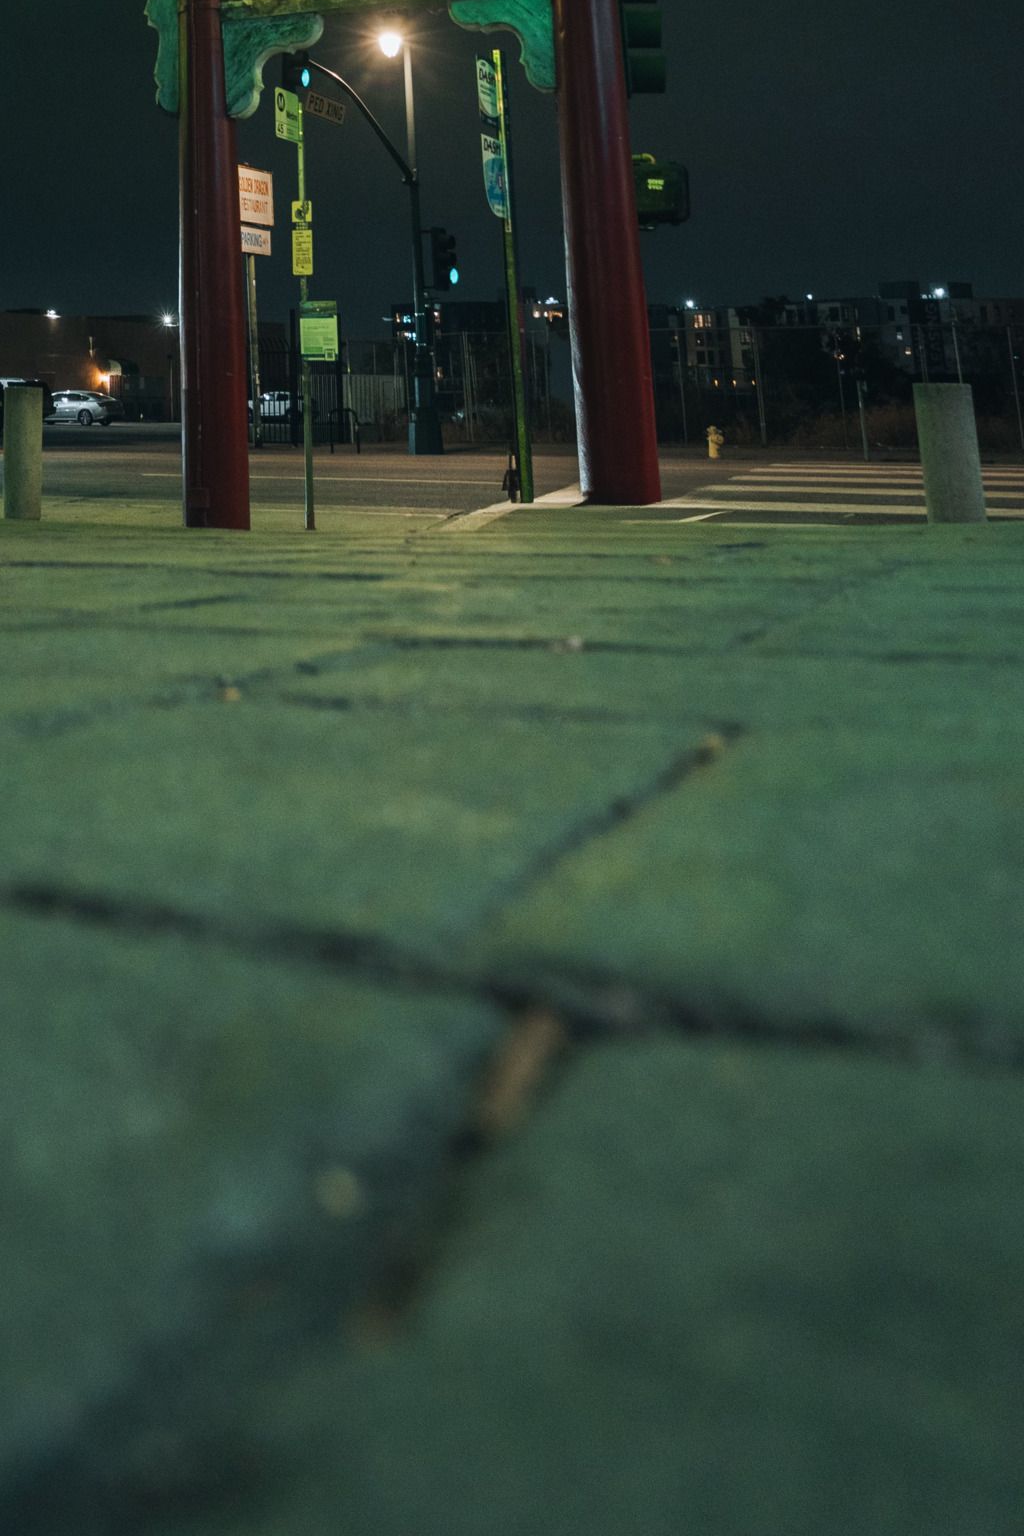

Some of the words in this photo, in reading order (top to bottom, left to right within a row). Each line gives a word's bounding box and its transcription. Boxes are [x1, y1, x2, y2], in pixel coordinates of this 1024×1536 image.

[308, 94, 324, 113] PED
[326, 101, 343, 121] XING
[483, 138, 501, 156] DASH
[241, 197, 268, 214] RESTURANT
[241, 231, 262, 248] PARKING
